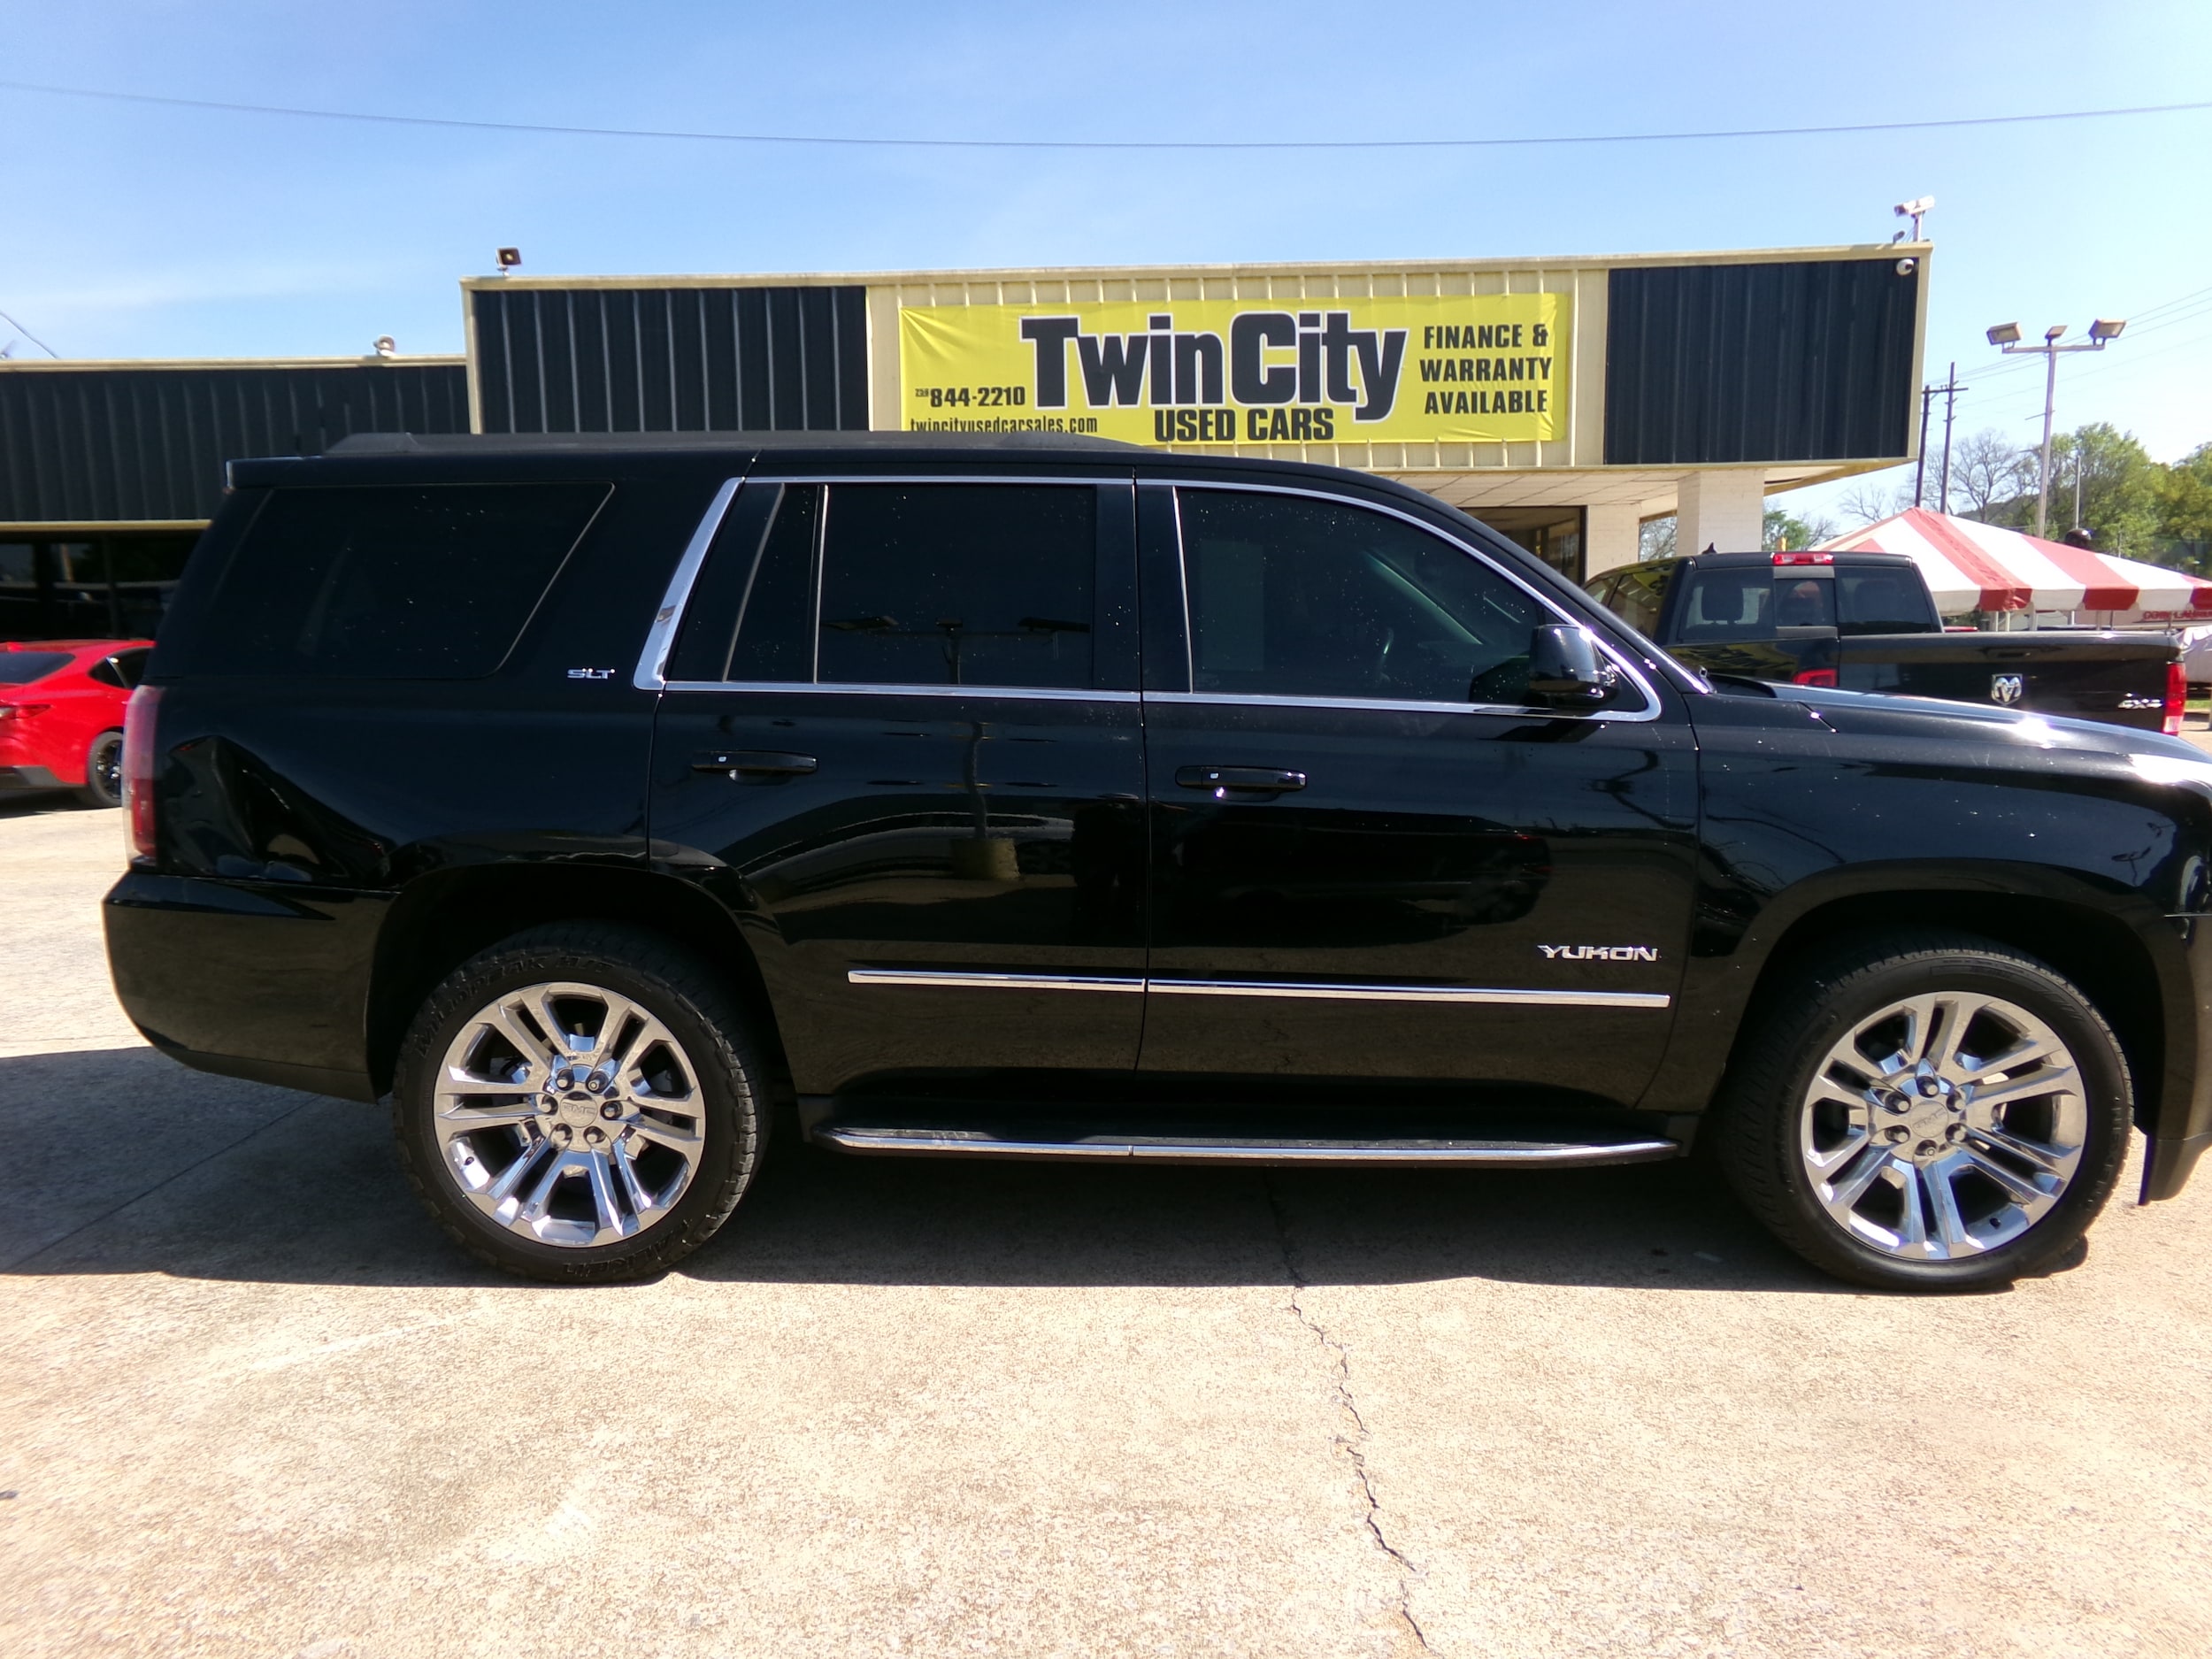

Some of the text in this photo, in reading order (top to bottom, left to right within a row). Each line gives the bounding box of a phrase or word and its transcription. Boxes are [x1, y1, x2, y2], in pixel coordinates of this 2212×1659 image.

[1424, 324, 1549, 349] FINANCE &
[1419, 357, 1553, 382] WARRANTY
[930, 386, 1025, 407] 844-2210
[1424, 390, 1548, 415] AVAILABLE
[1154, 408, 1334, 442] USED CARS
[567, 668, 614, 680] SLT
[1537, 944, 1658, 962] YUKON
